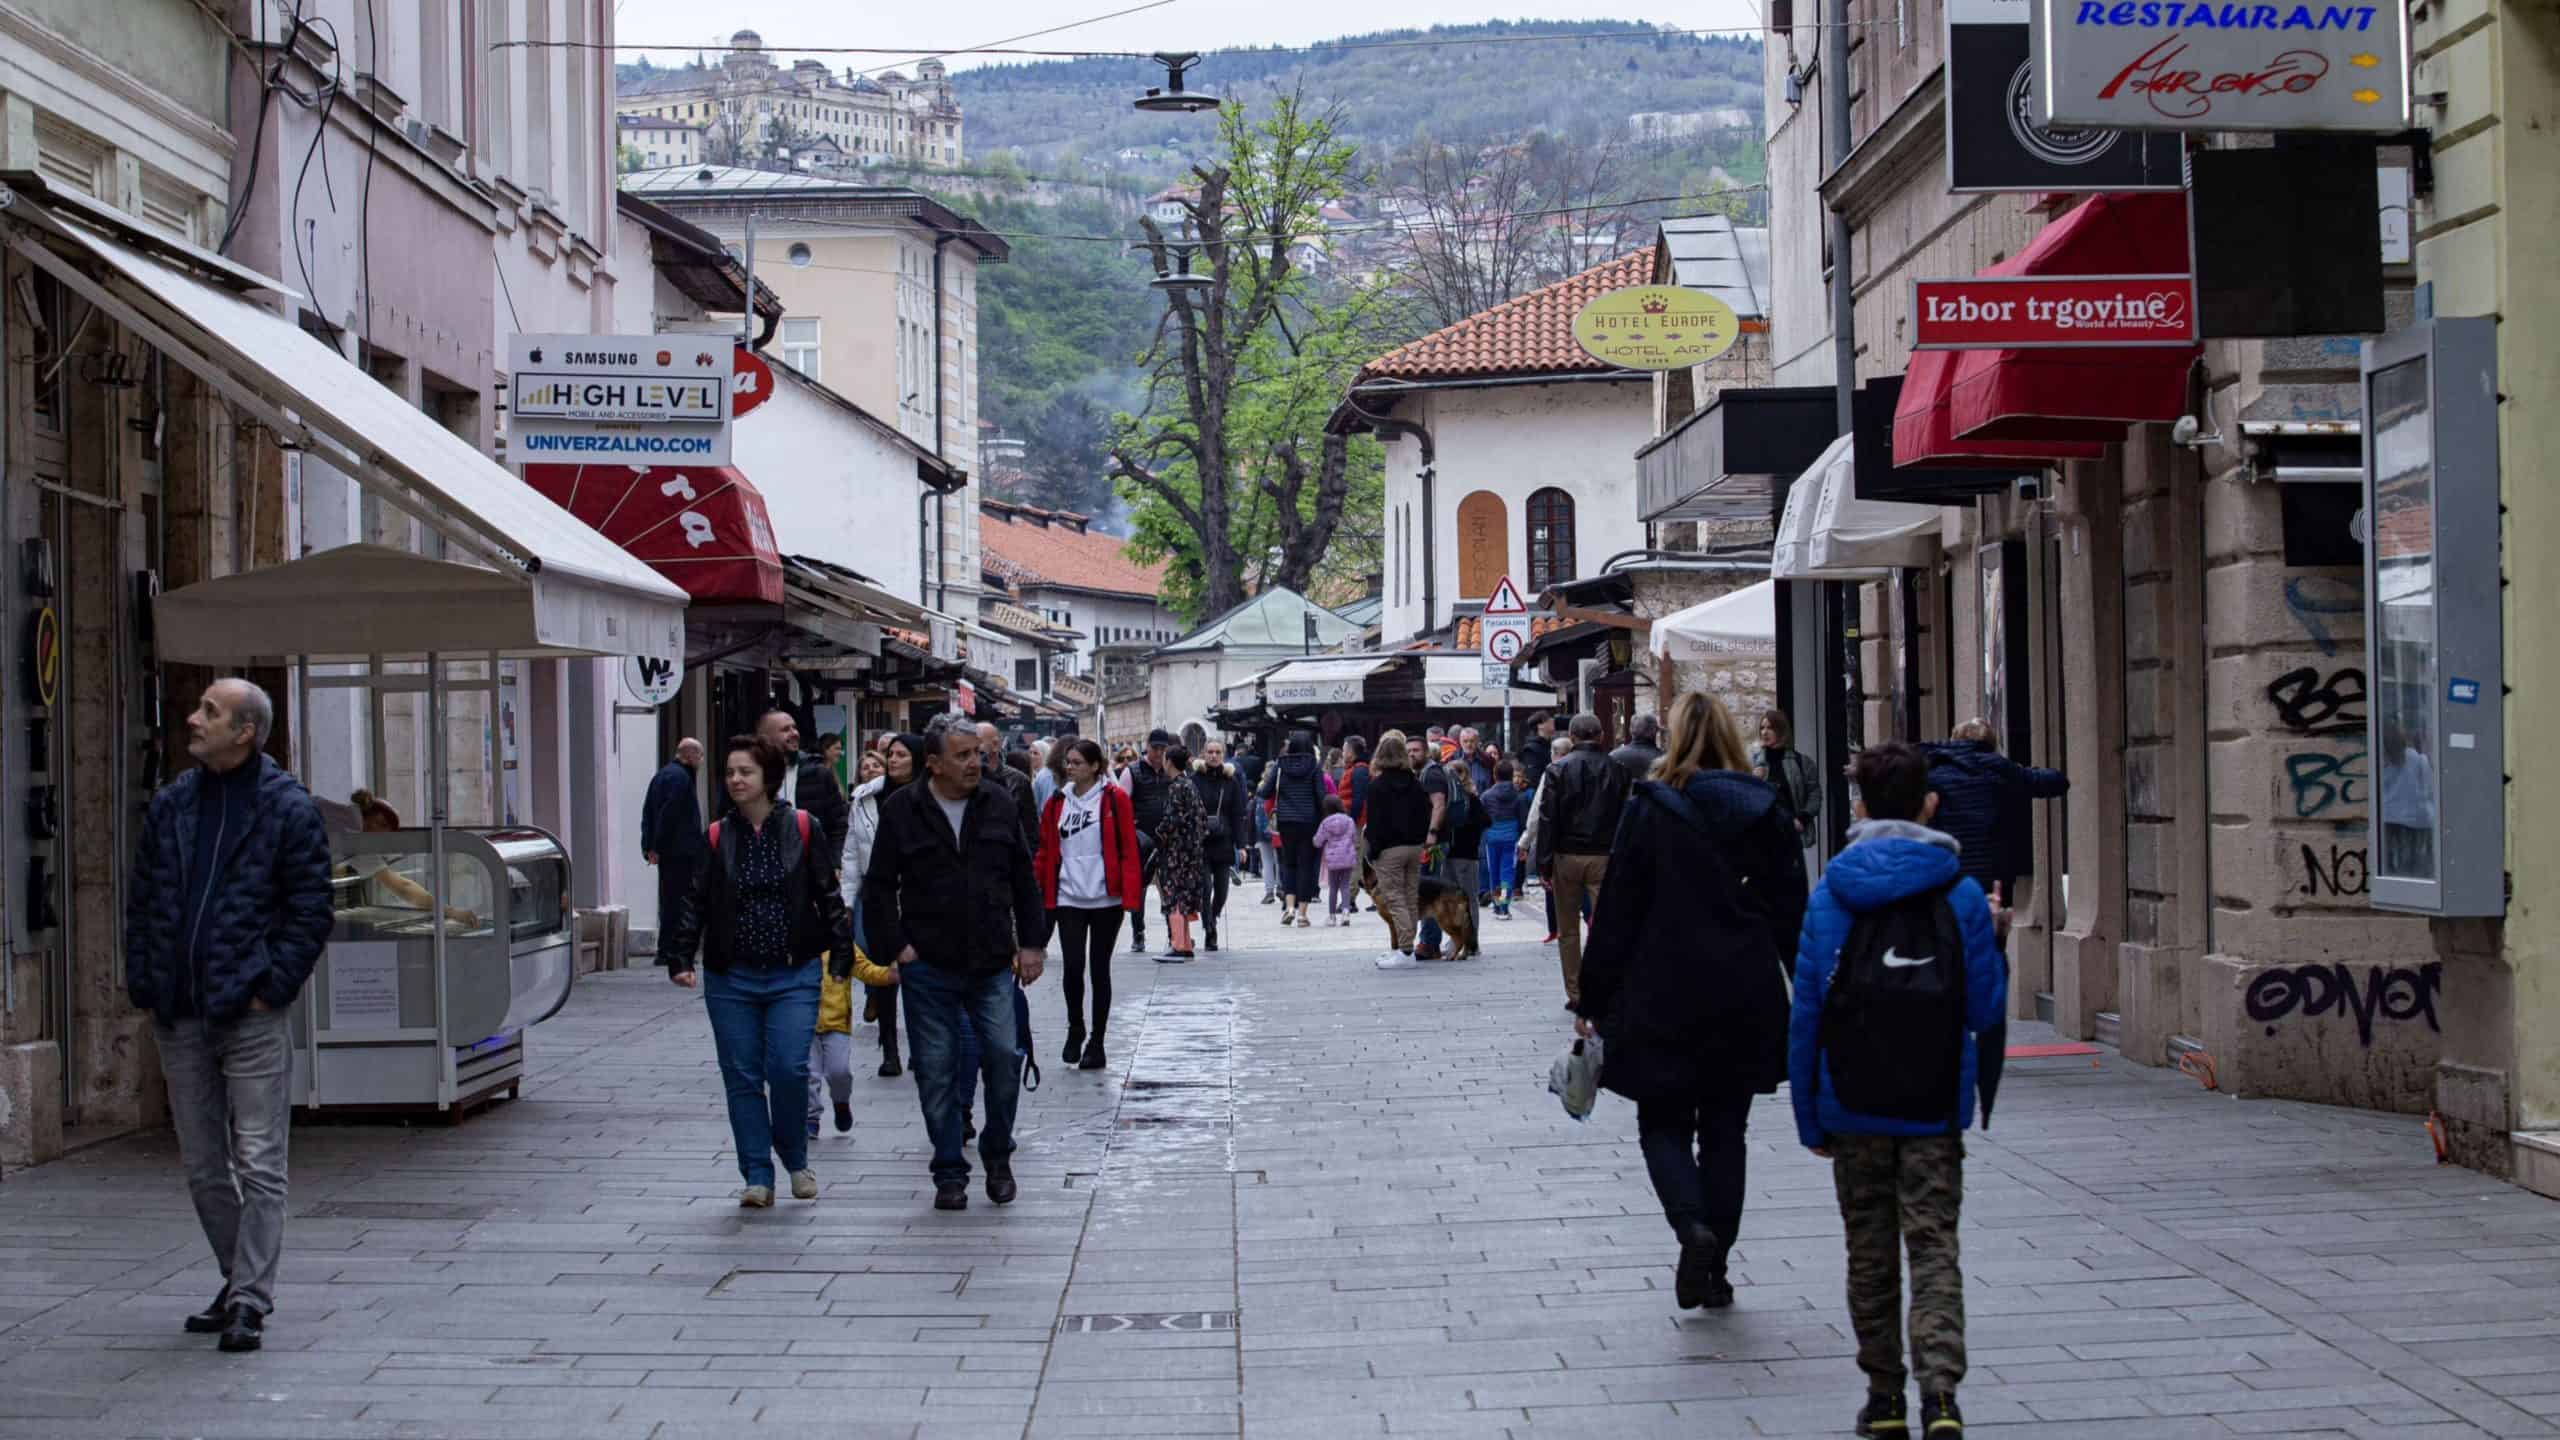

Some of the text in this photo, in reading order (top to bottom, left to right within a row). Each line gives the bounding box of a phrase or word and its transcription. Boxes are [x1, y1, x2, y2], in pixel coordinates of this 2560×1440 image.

[2076, 1, 2377, 31] RESTAURANT
[1925, 293, 2166, 329] Izbor trgovine
[1595, 314, 1717, 328] HOTEL EUROPE
[2075, 318, 2155, 329] World of beauty
[1605, 344, 1712, 356] HOTEL ART
[565, 351, 638, 365] SAMSUNG
[553, 383, 714, 409] HIGH LEVEL
[568, 410, 595, 418] MOBILE
[619, 411, 667, 419] ACCESSORIES
[525, 434, 712, 454] UNIVERZALNO.COM
